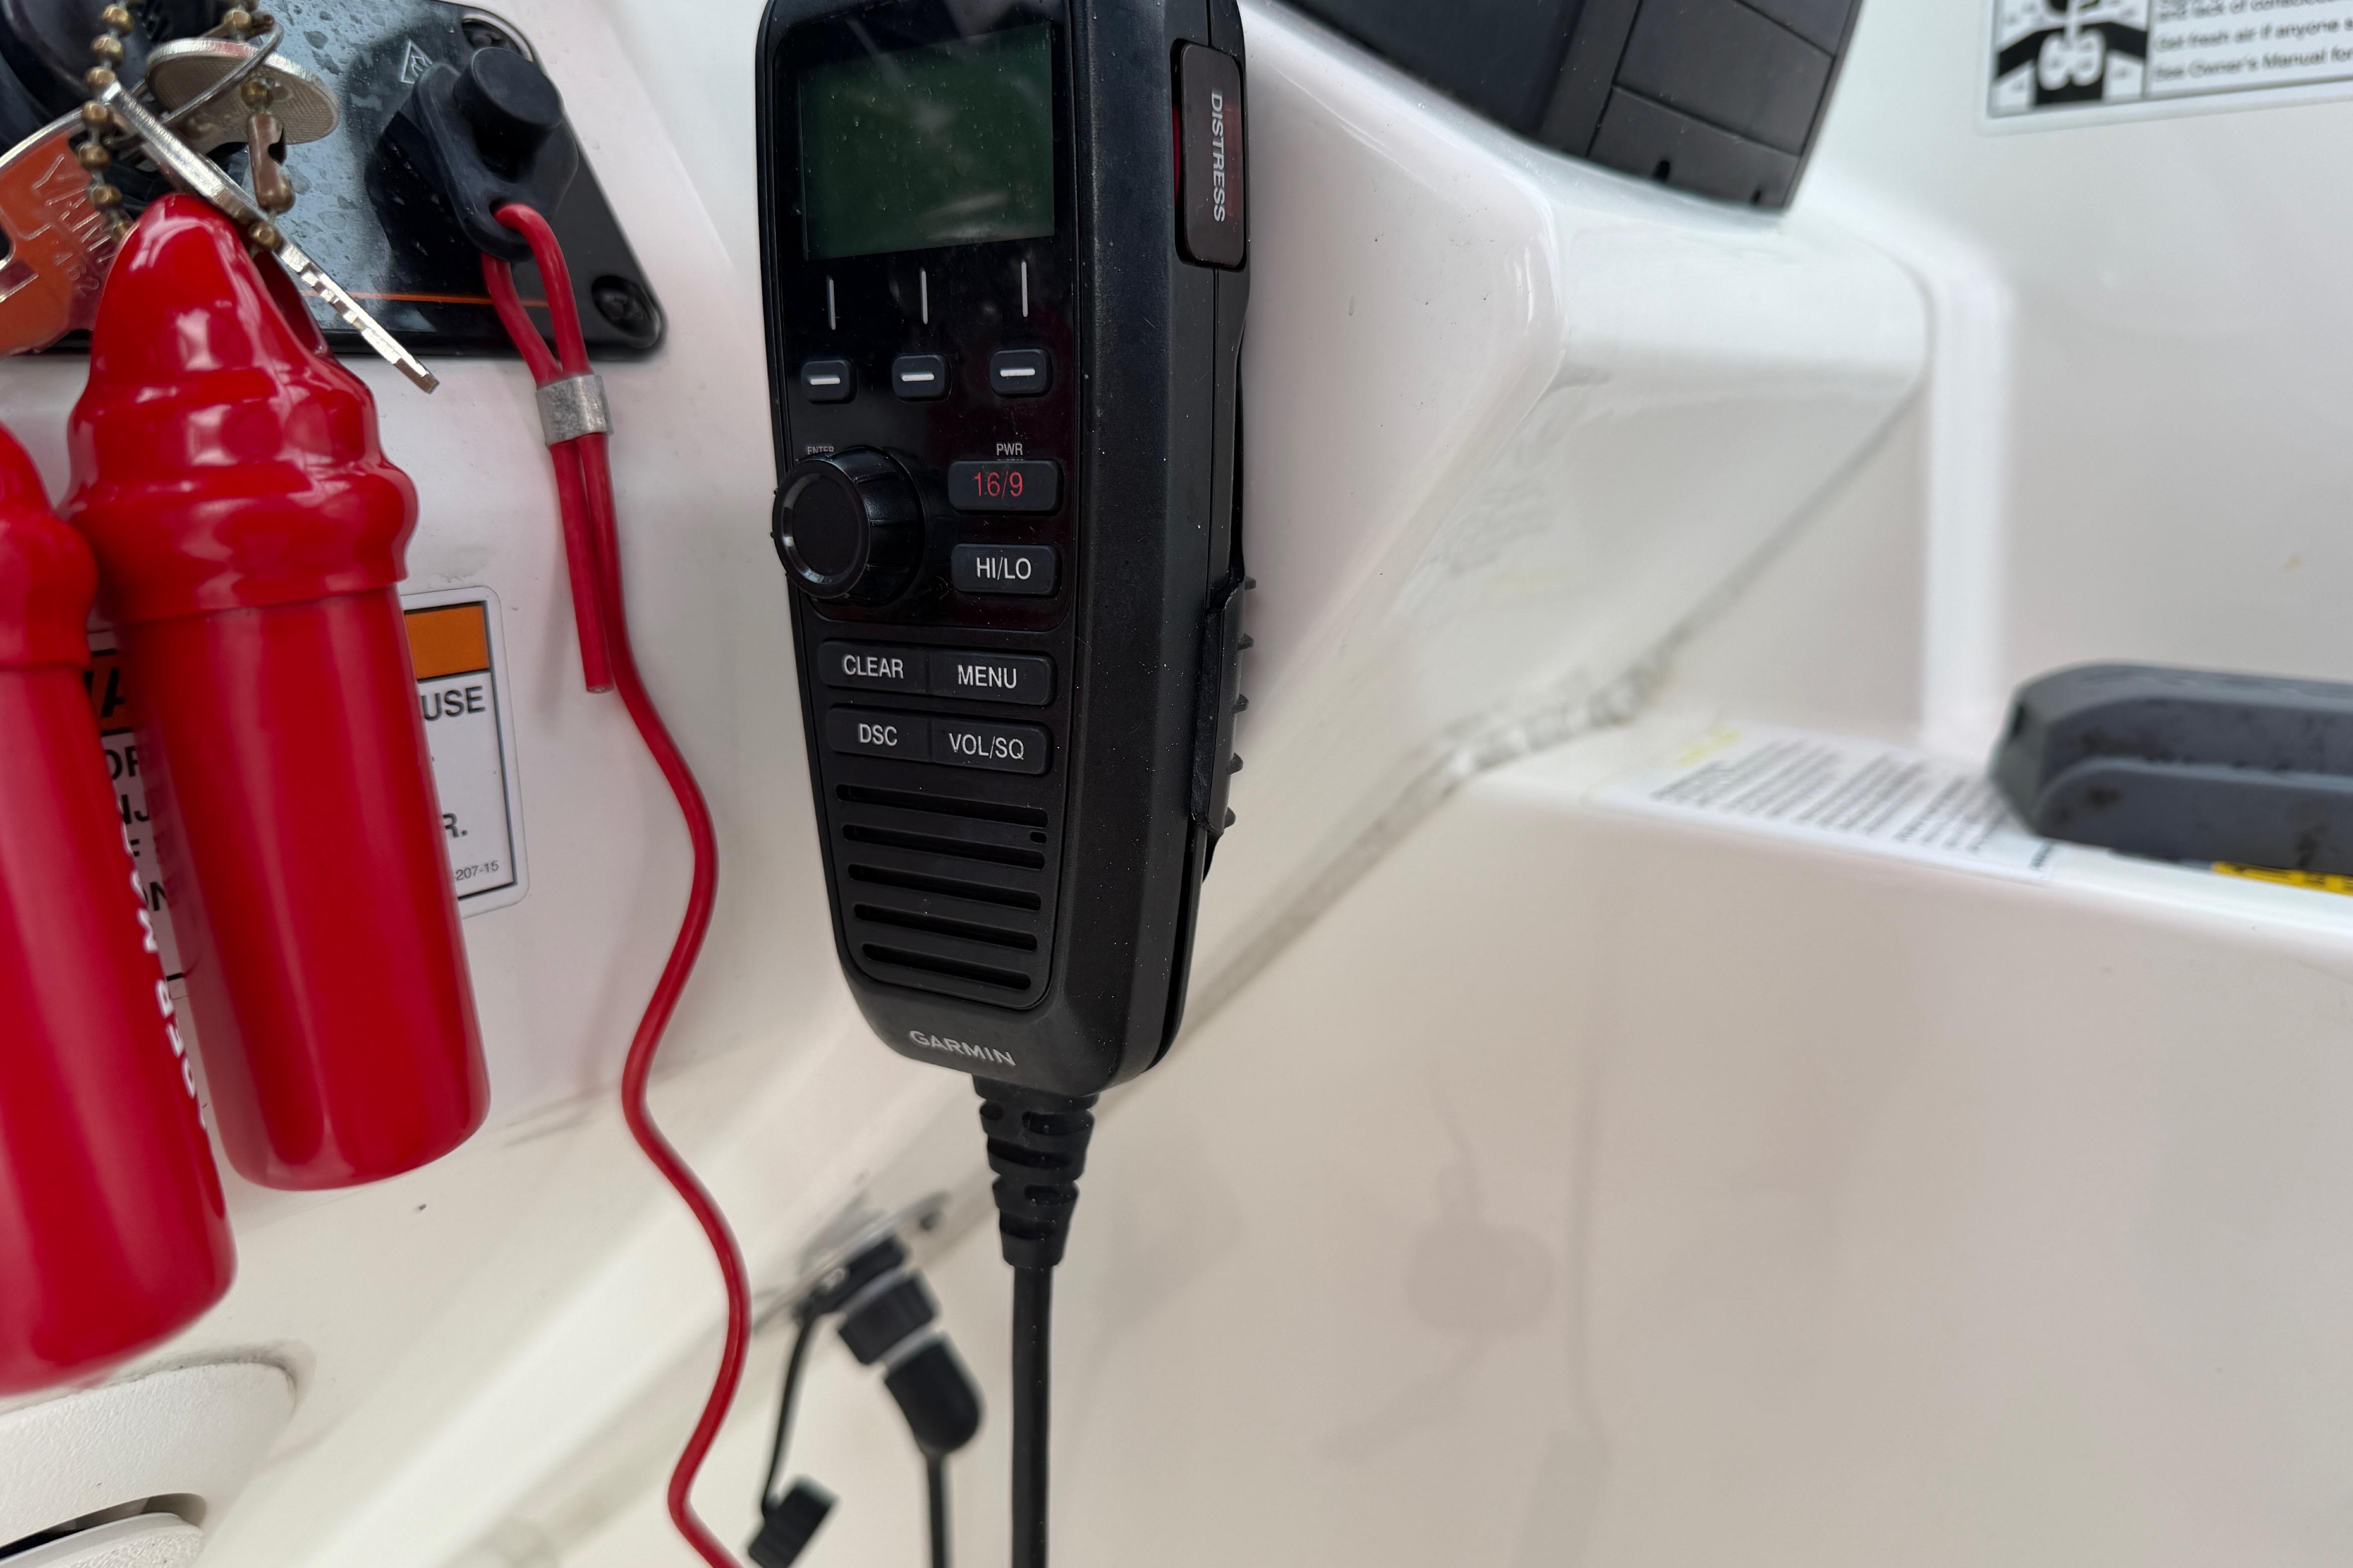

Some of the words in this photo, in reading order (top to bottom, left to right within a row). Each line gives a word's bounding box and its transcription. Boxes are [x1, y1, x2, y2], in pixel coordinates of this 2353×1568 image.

[2275, 19, 2339, 40] anyone
[2189, 57, 2258, 78] Owner's
[2261, 49, 2326, 70] Manual
[2331, 44, 2353, 62] for
[1211, 93, 1226, 222] DISTRESS
[996, 443, 1023, 456] PWR
[973, 471, 1023, 498] 16/9
[976, 557, 1031, 581] HI/LO
[843, 654, 904, 679] CLEAR
[957, 665, 1017, 689] MENU
[859, 723, 898, 746] DSC
[948, 733, 1024, 760] VOL/SQ
[910, 1030, 1016, 1066] GARMIN
